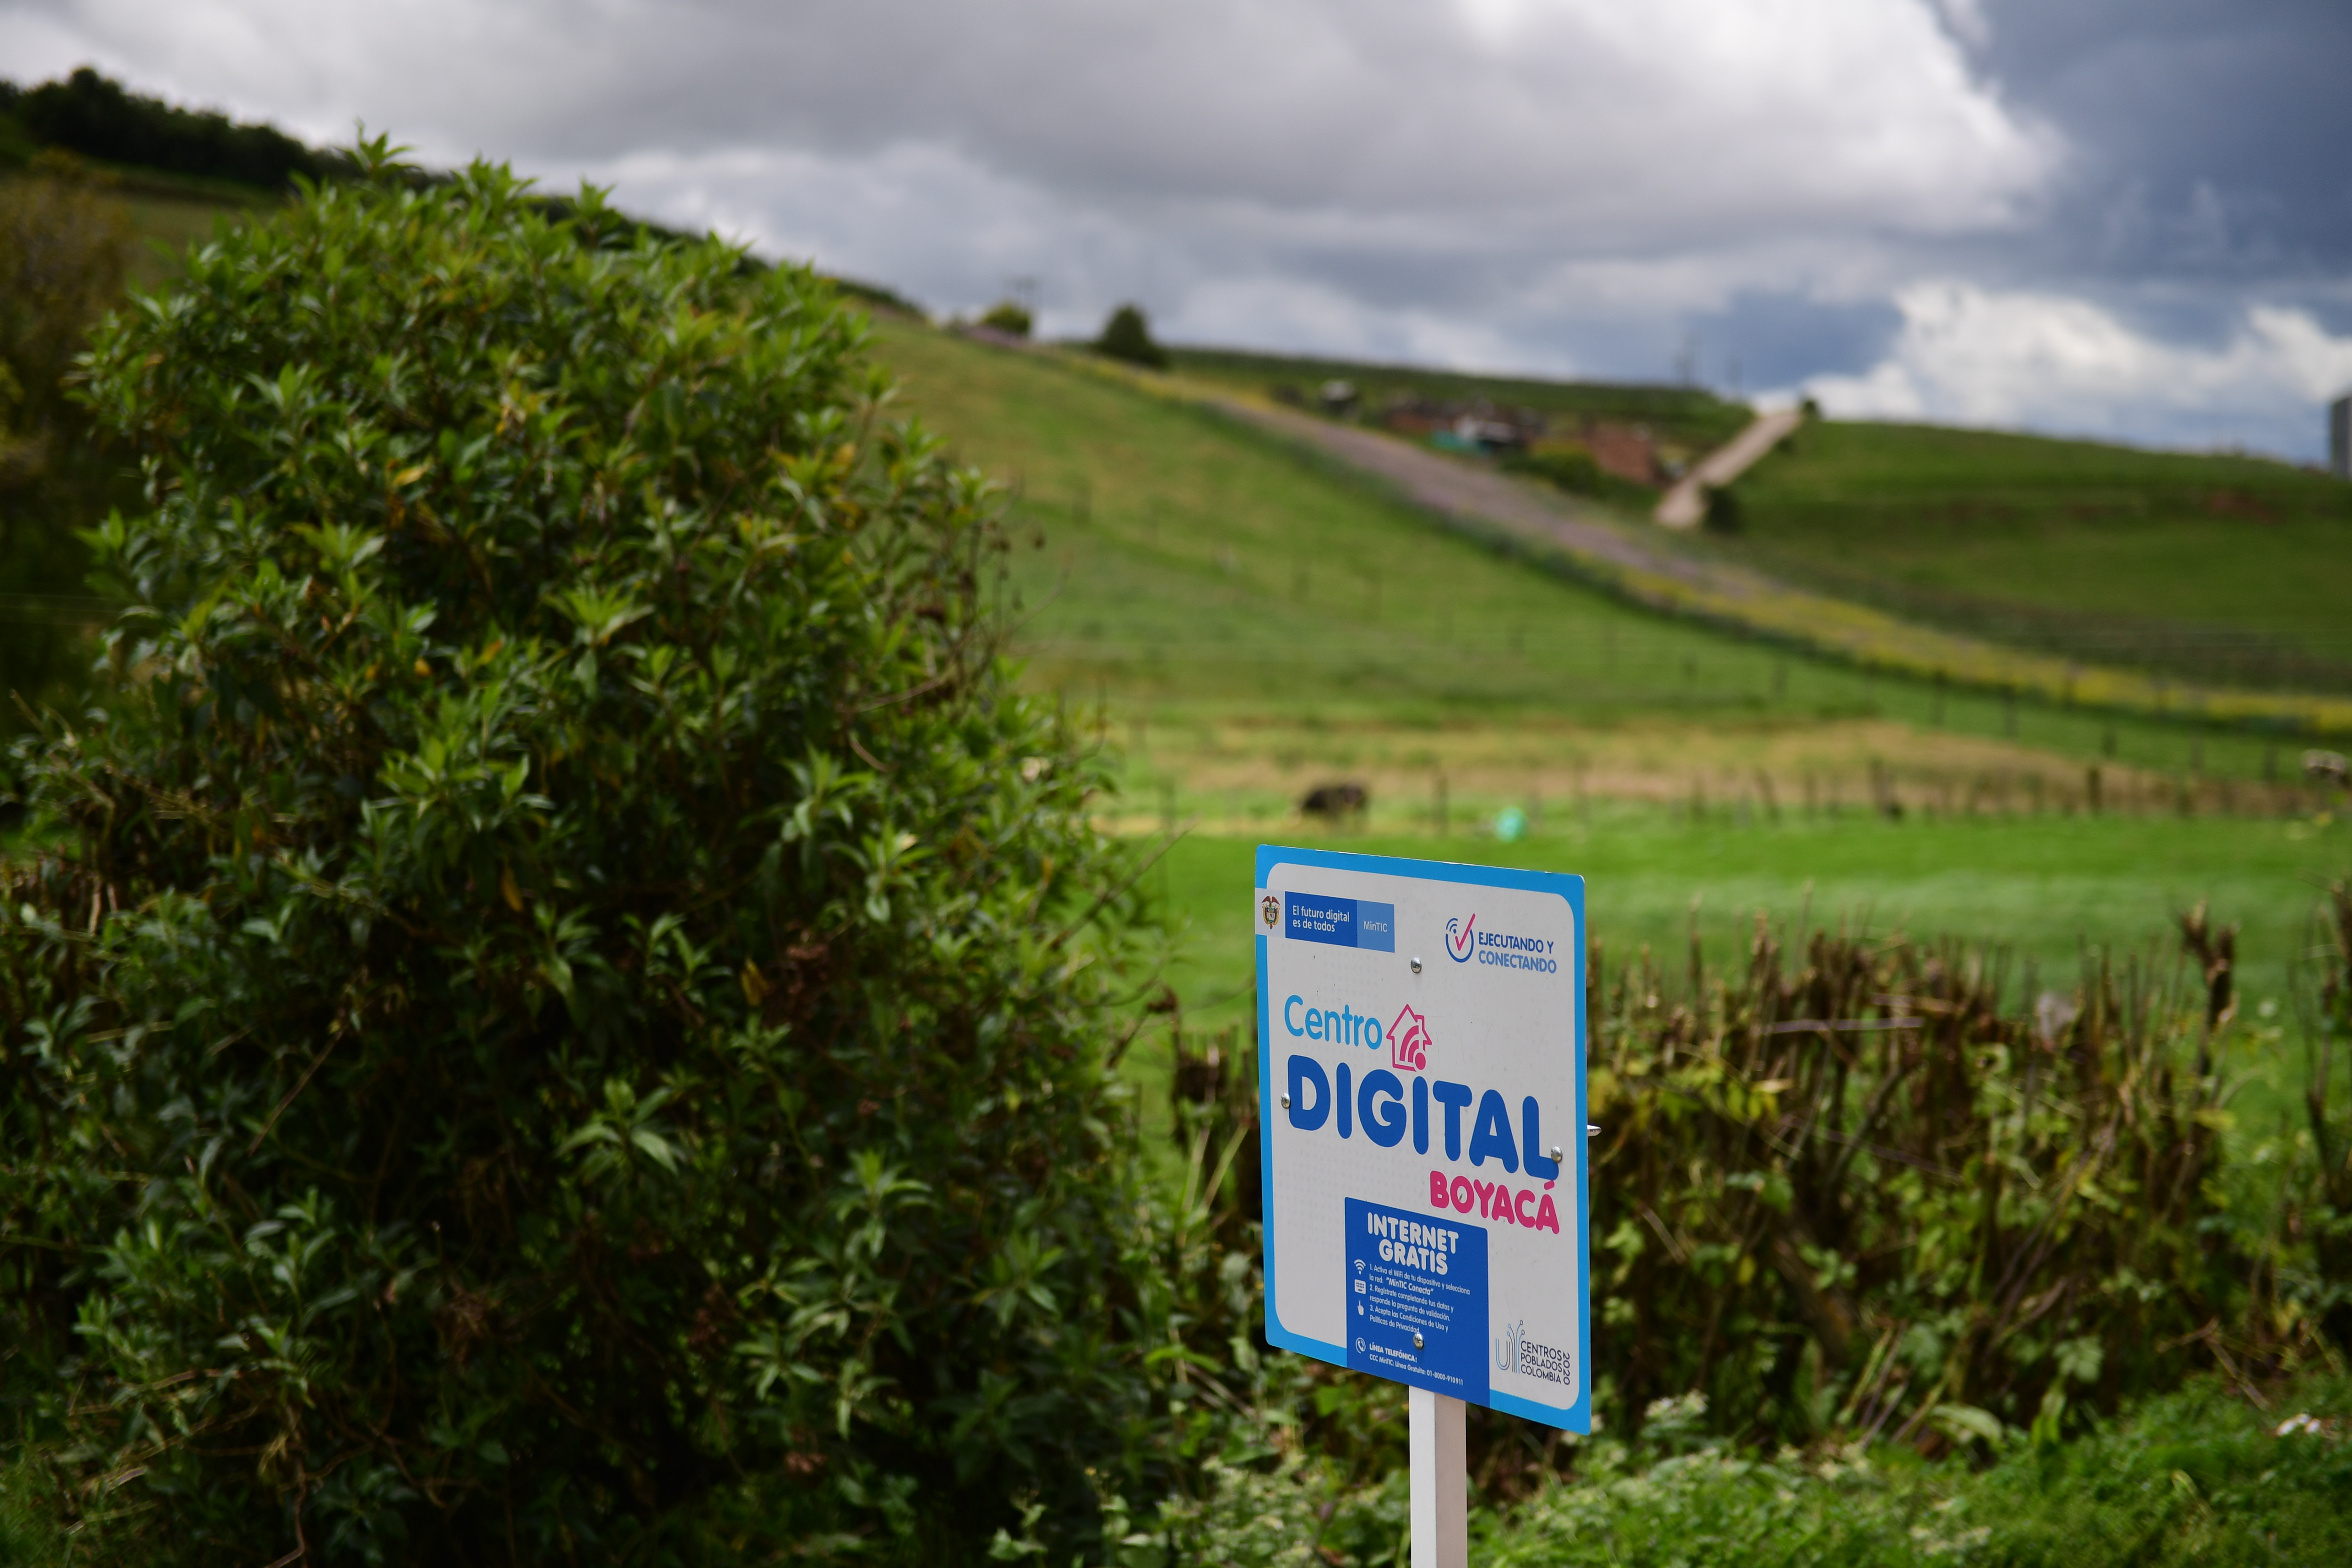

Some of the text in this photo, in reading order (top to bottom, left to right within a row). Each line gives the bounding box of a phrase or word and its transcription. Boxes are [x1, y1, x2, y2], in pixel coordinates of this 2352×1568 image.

[1293, 905, 1350, 923] El futuro digital
[1293, 918, 1335, 932] es de todos
[1364, 920, 1388, 932] MinTIC
[1479, 932, 1554, 954] EJECUTANDO Y
[1478, 950, 1557, 974] CONECTANDO
[1284, 995, 1383, 1050] Centro
[1288, 1054, 1559, 1181] DIGITAL
[1430, 1170, 1560, 1234] BOYACÁ
[1368, 1212, 1459, 1254] INTERNET
[1379, 1239, 1448, 1275] GRATIS
[1374, 1265, 1387, 1274] Activa
[1394, 1269, 1403, 1278] WiFi
[1404, 1272, 1410, 1280] de
[1417, 1275, 1441, 1288] dispositivo
[1446, 1283, 1470, 1295] selecciona
[1369, 1295, 1391, 1306] responde
[1397, 1302, 1418, 1313] pregunta
[1419, 1307, 1425, 1315] de
[1426, 1309, 1450, 1321] validación.
[1398, 1293, 1428, 1305] completando
[1437, 1301, 1450, 1311] datos
[1375, 1306, 1391, 1316] Acepta
[1399, 1312, 1427, 1326] Condiciones
[1428, 1319, 1435, 1327] de
[1435, 1321, 1445, 1330] Uso
[1369, 1342, 1417, 1363] LÍNEA TELEFÓNICA:
[1521, 1340, 1562, 1361] CENTROS
[1521, 1353, 1562, 1372] POBLADOS
[1426, 1369, 1463, 1386] 01-8000-910911
[1521, 1364, 1561, 1384] COLOMBIA
